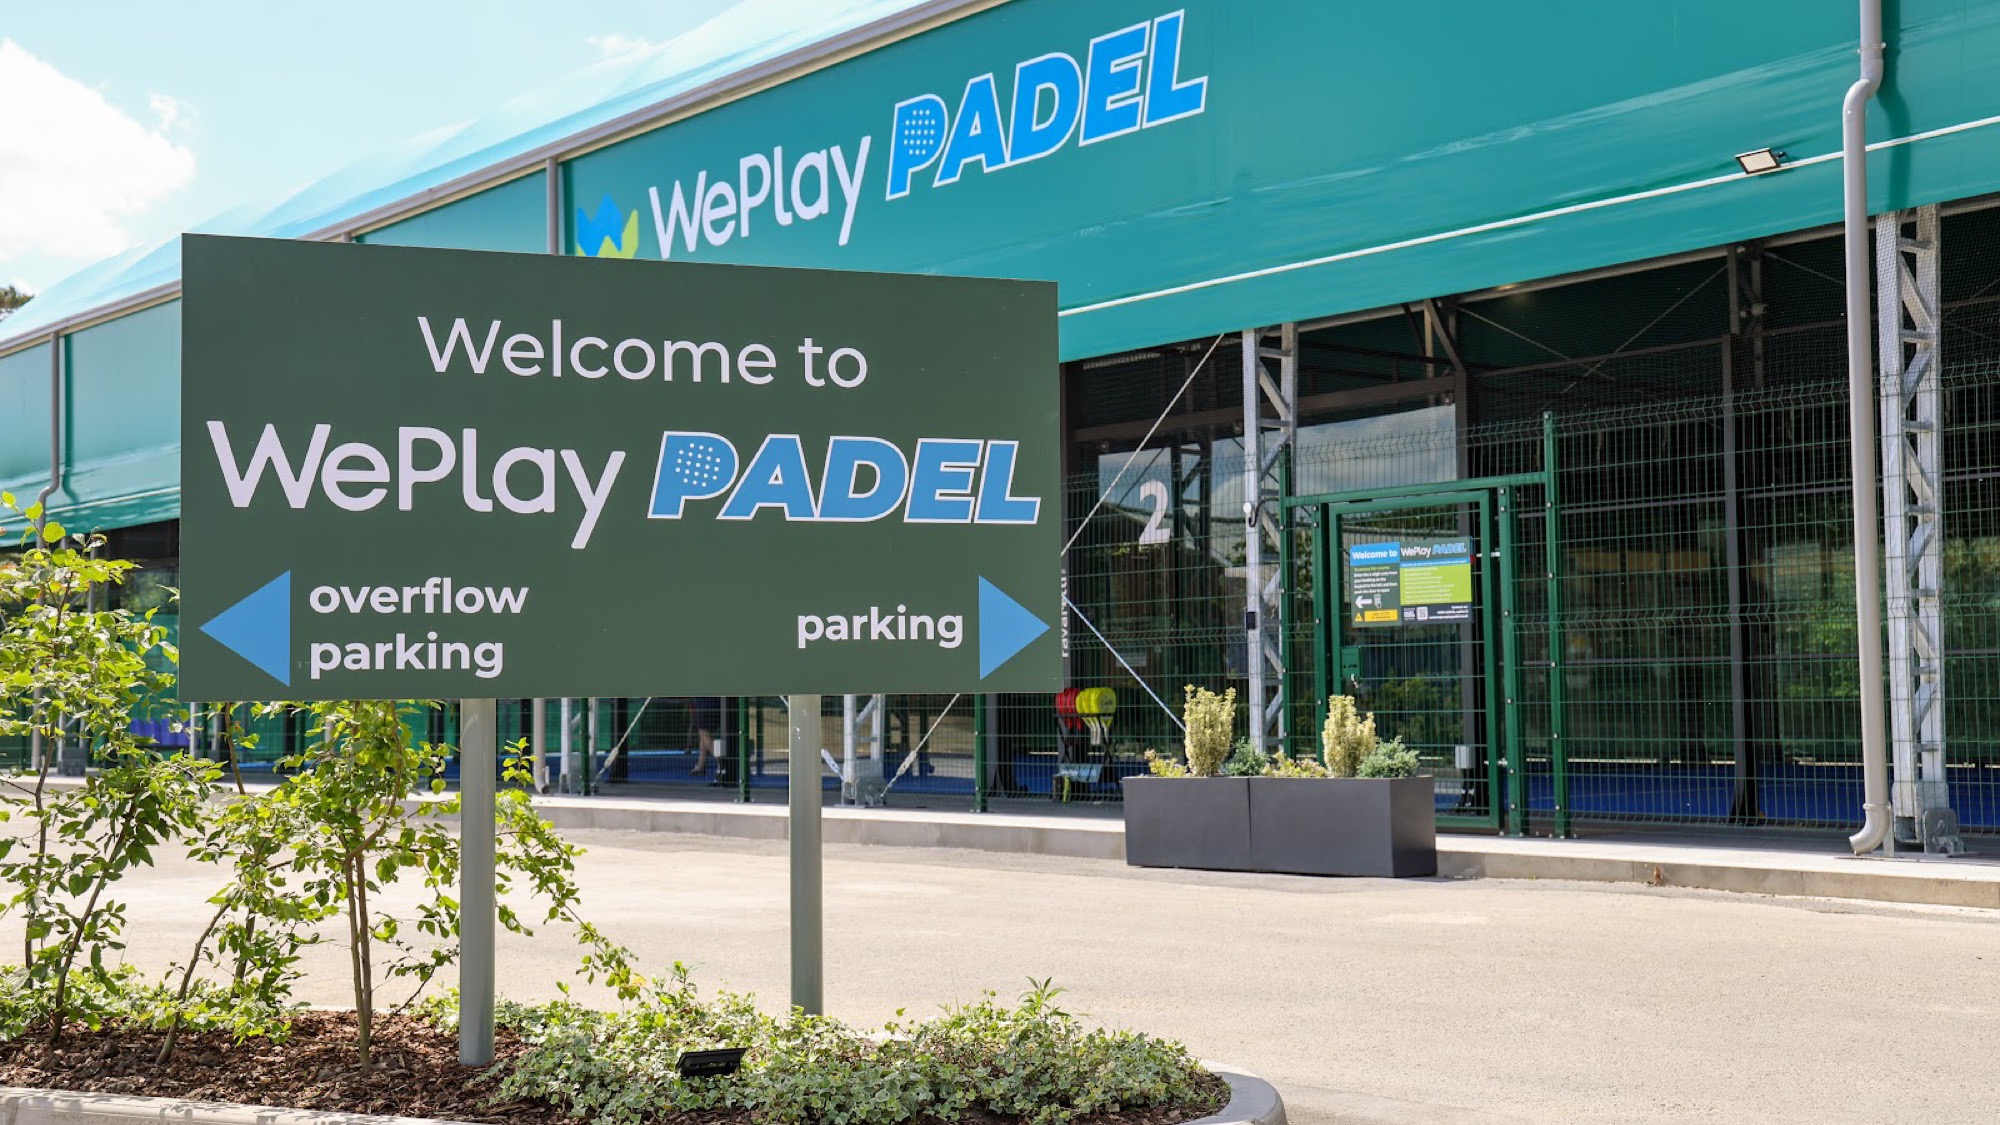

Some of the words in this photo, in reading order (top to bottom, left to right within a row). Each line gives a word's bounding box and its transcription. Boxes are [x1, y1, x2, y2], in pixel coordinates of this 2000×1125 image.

[648, 135, 872, 259] WePlay
[885, 8, 1208, 201] PADEL
[418, 317, 776, 385] Welcome
[799, 337, 868, 388] to
[206, 421, 626, 550] WePlay
[647, 430, 1041, 525] PADEL
[1139, 480, 1171, 545] 2
[1352, 551, 1387, 559] Welcome
[1389, 549, 1398, 557] to
[1400, 546, 1431, 558] WePlay
[310, 577, 529, 614] overflow
[796, 604, 964, 650] parking
[310, 631, 503, 679] parking
